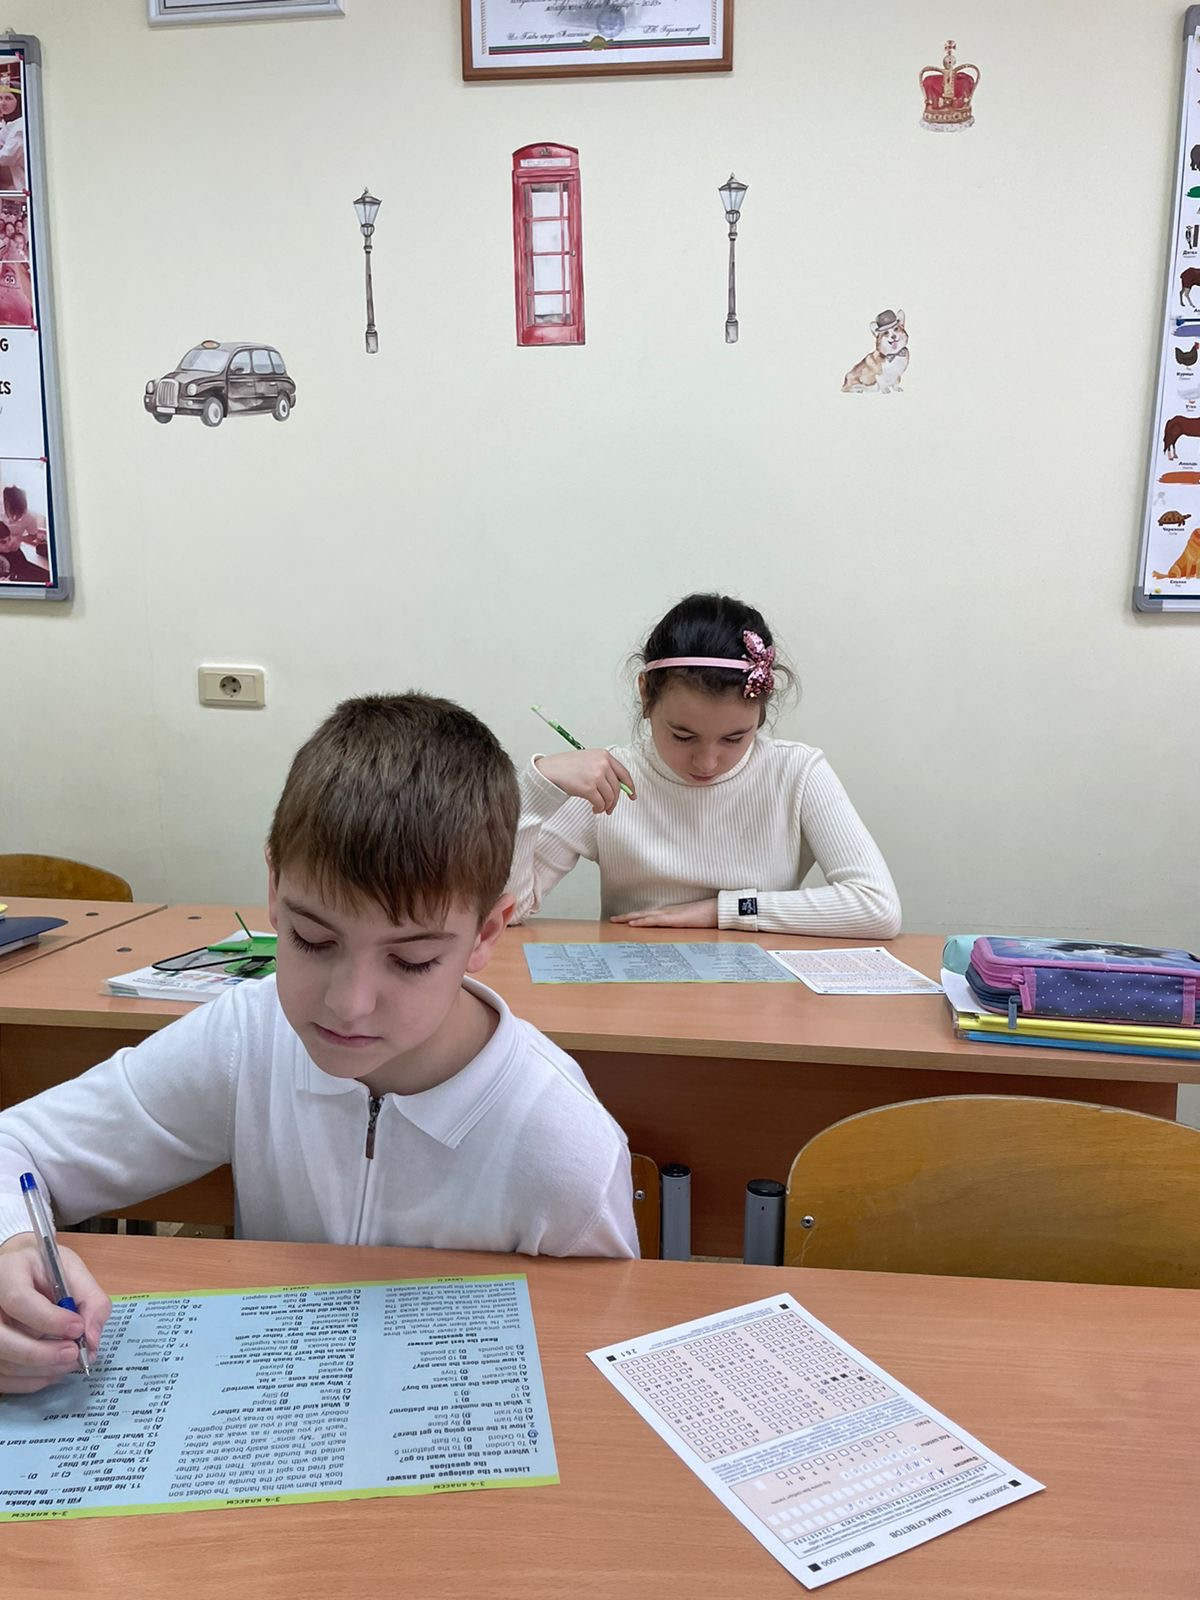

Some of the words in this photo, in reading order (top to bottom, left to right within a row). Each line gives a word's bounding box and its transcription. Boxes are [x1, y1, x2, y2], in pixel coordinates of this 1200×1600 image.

[399, 1455, 414, 1463] go?
[88, 1484, 112, 1492] didn't
[925, 1509, 952, 1523] БЛАНК
[889, 1520, 926, 1538] ОТВЕТОВ
[850, 1541, 875, 1554] BRITISH
[821, 1551, 852, 1566] BULLDOG
